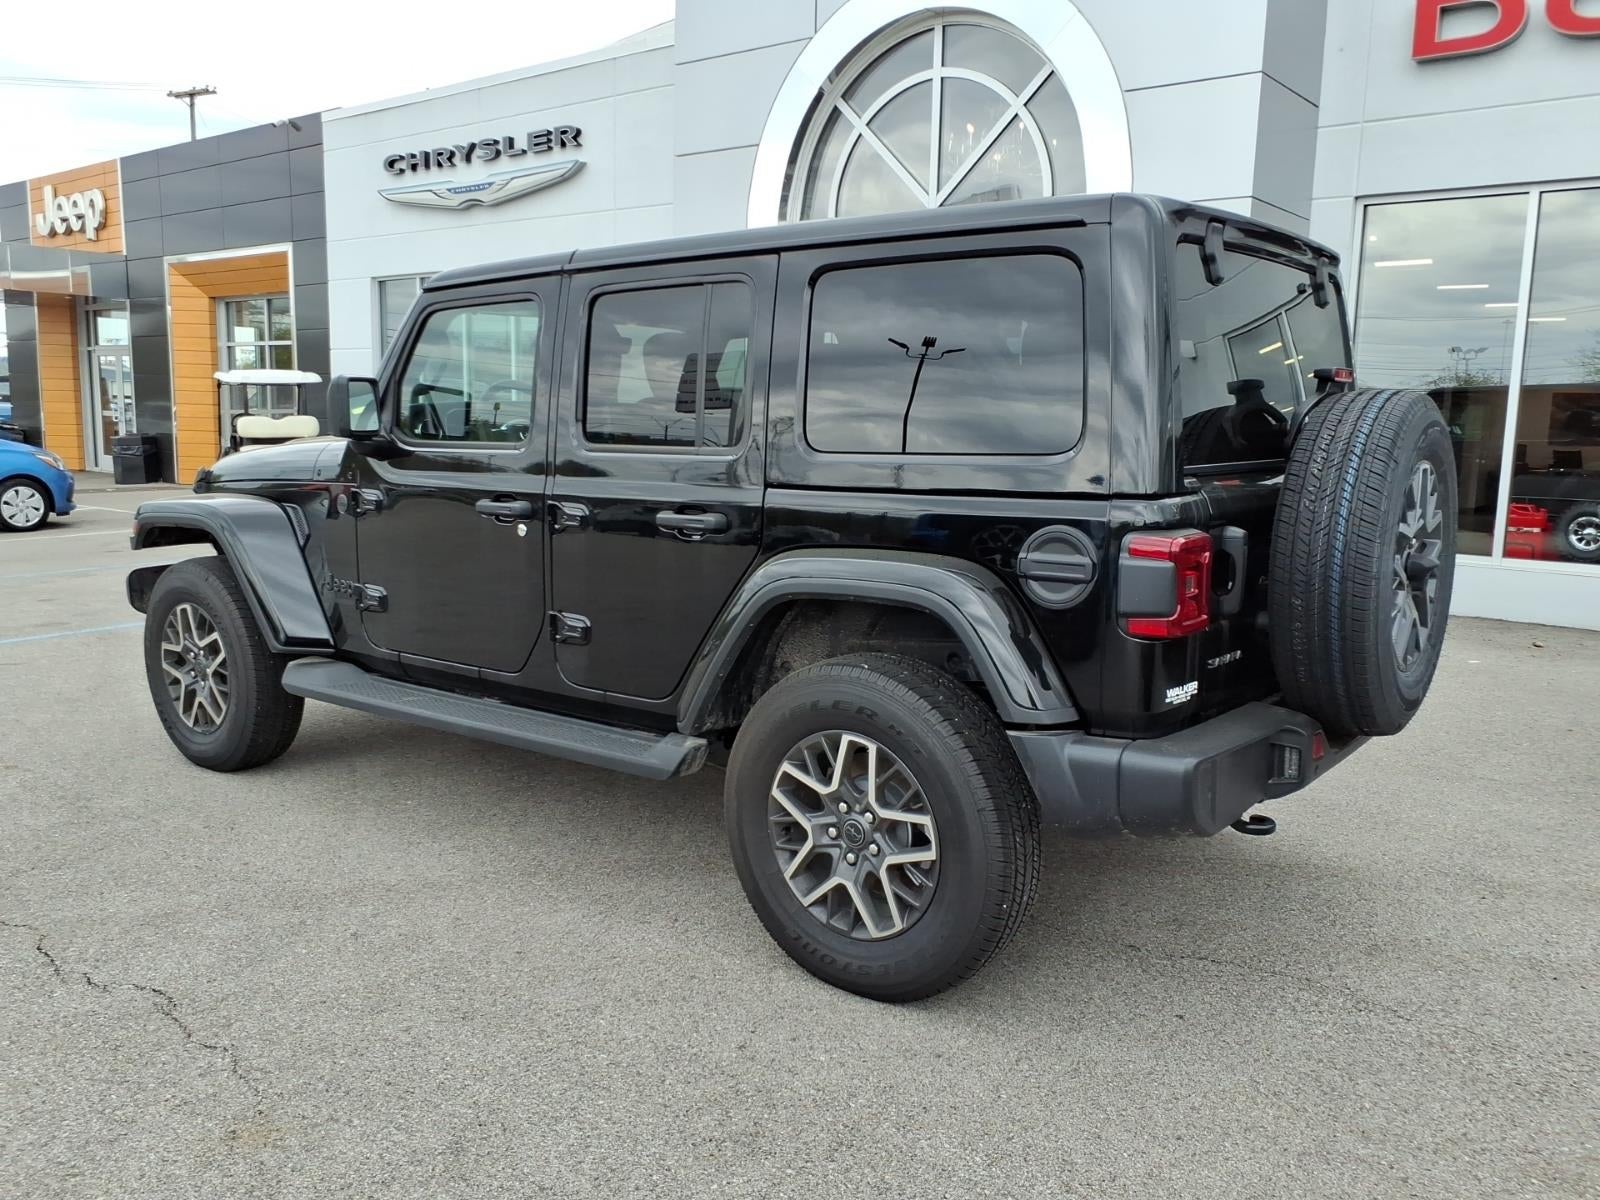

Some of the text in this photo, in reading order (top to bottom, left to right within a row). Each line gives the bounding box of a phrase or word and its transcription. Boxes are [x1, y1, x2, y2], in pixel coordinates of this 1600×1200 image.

[384, 125, 583, 174] CHRYSLER
[35, 184, 106, 241] Jeep
[1166, 681, 1198, 698] WALKER
